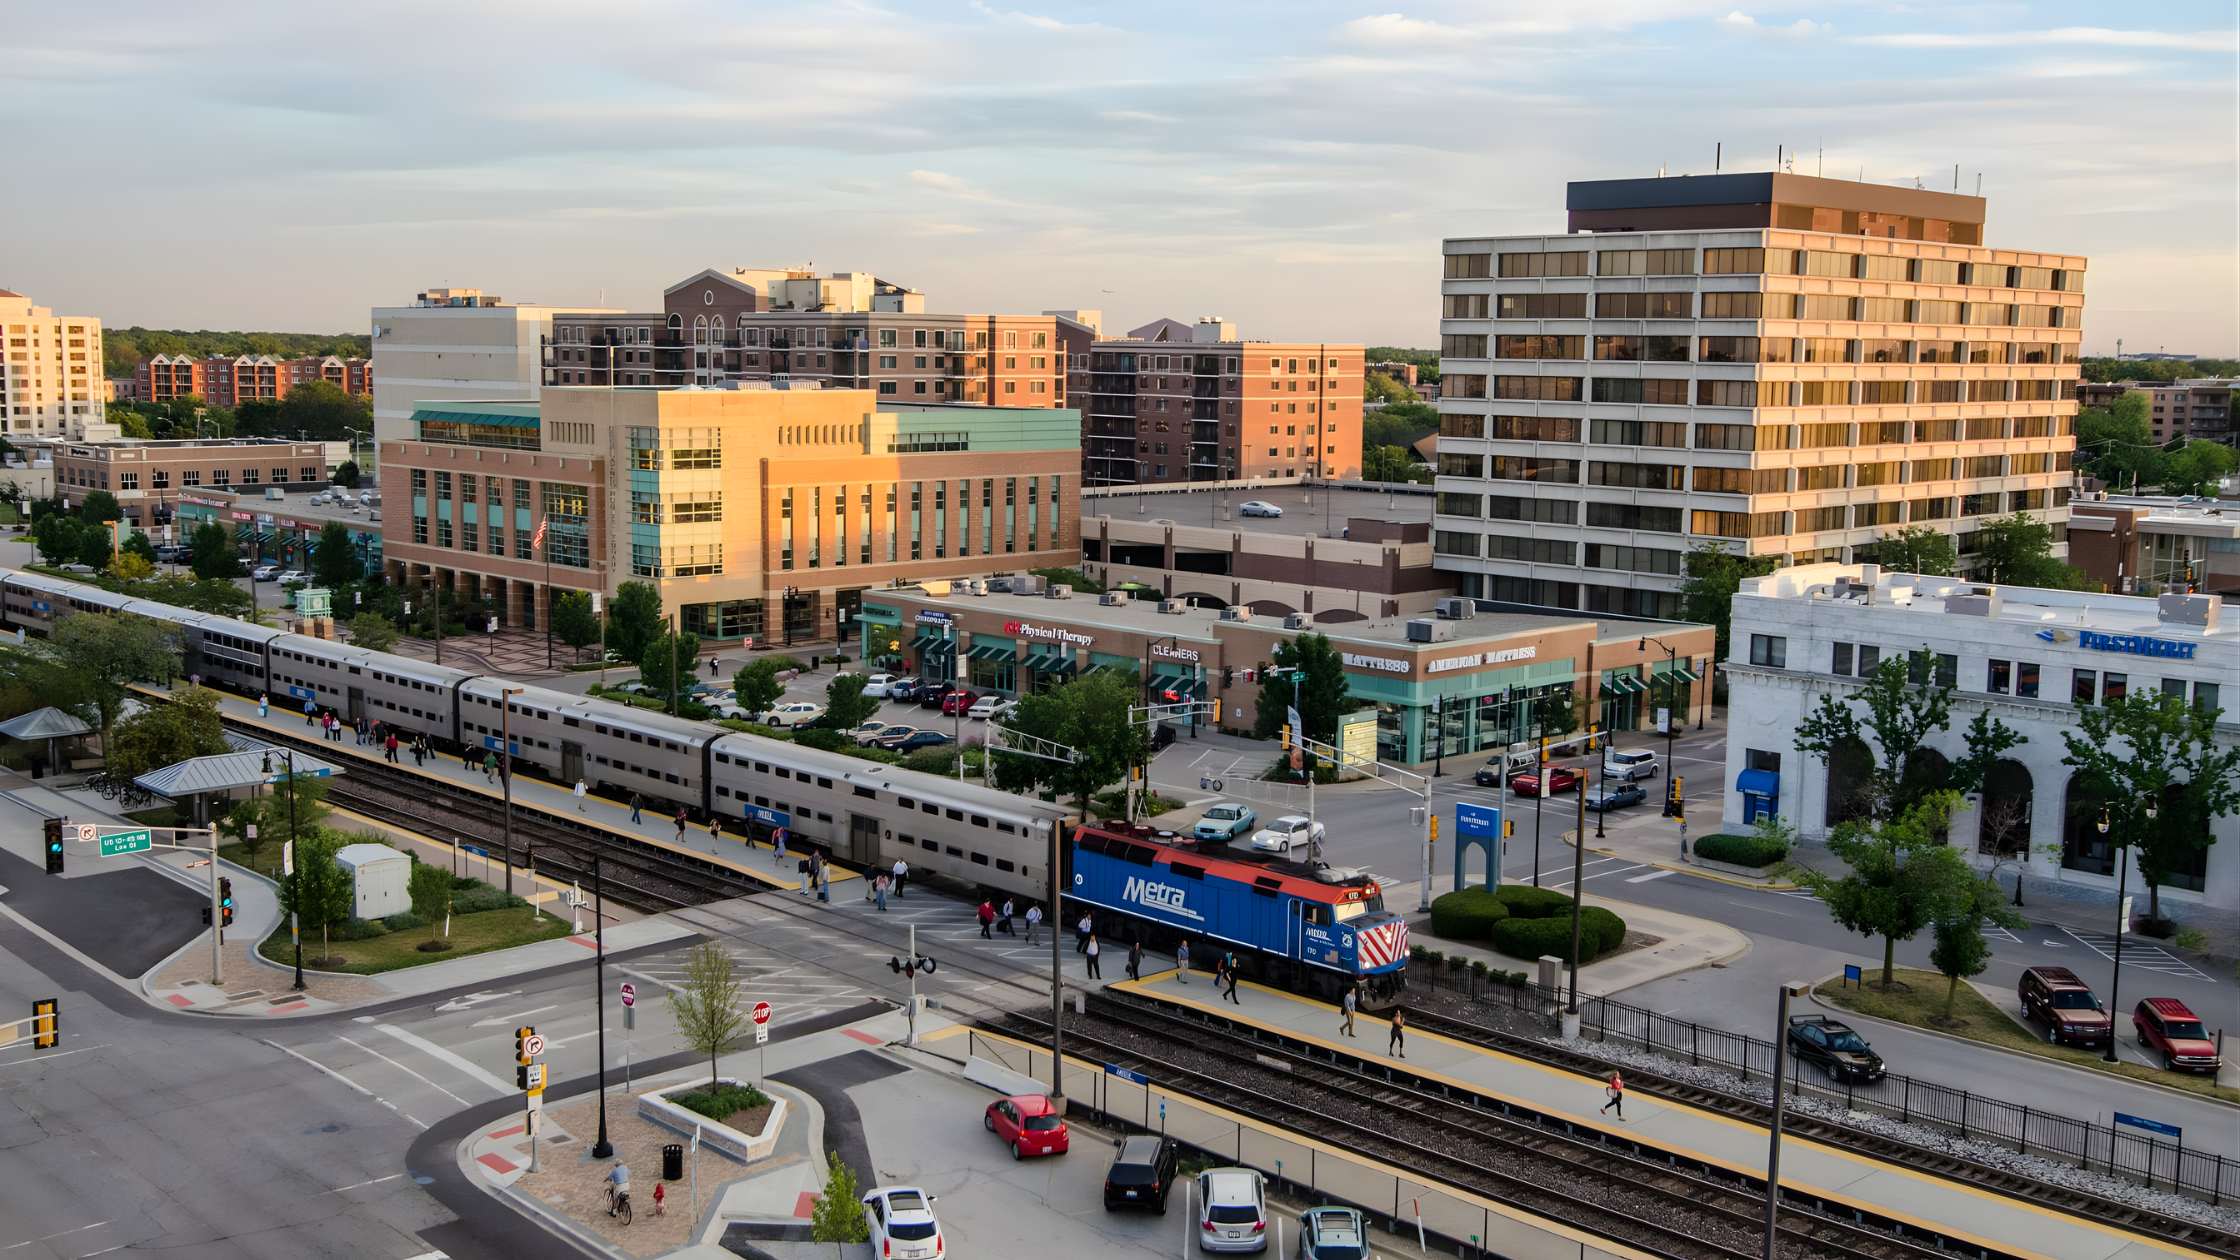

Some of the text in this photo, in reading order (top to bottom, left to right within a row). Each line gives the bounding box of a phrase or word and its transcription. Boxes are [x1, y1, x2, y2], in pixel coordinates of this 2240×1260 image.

[1020, 623, 1056, 638] Physical
[1058, 628, 1094, 646] Therapy
[1153, 644, 1199, 661] CLEANERS
[1342, 652, 1410, 673] MATTRESS
[1428, 646, 1536, 673] AMERICAN MATTRESS
[1122, 875, 1190, 910] Metra
[753, 1007, 771, 1019] STOP
